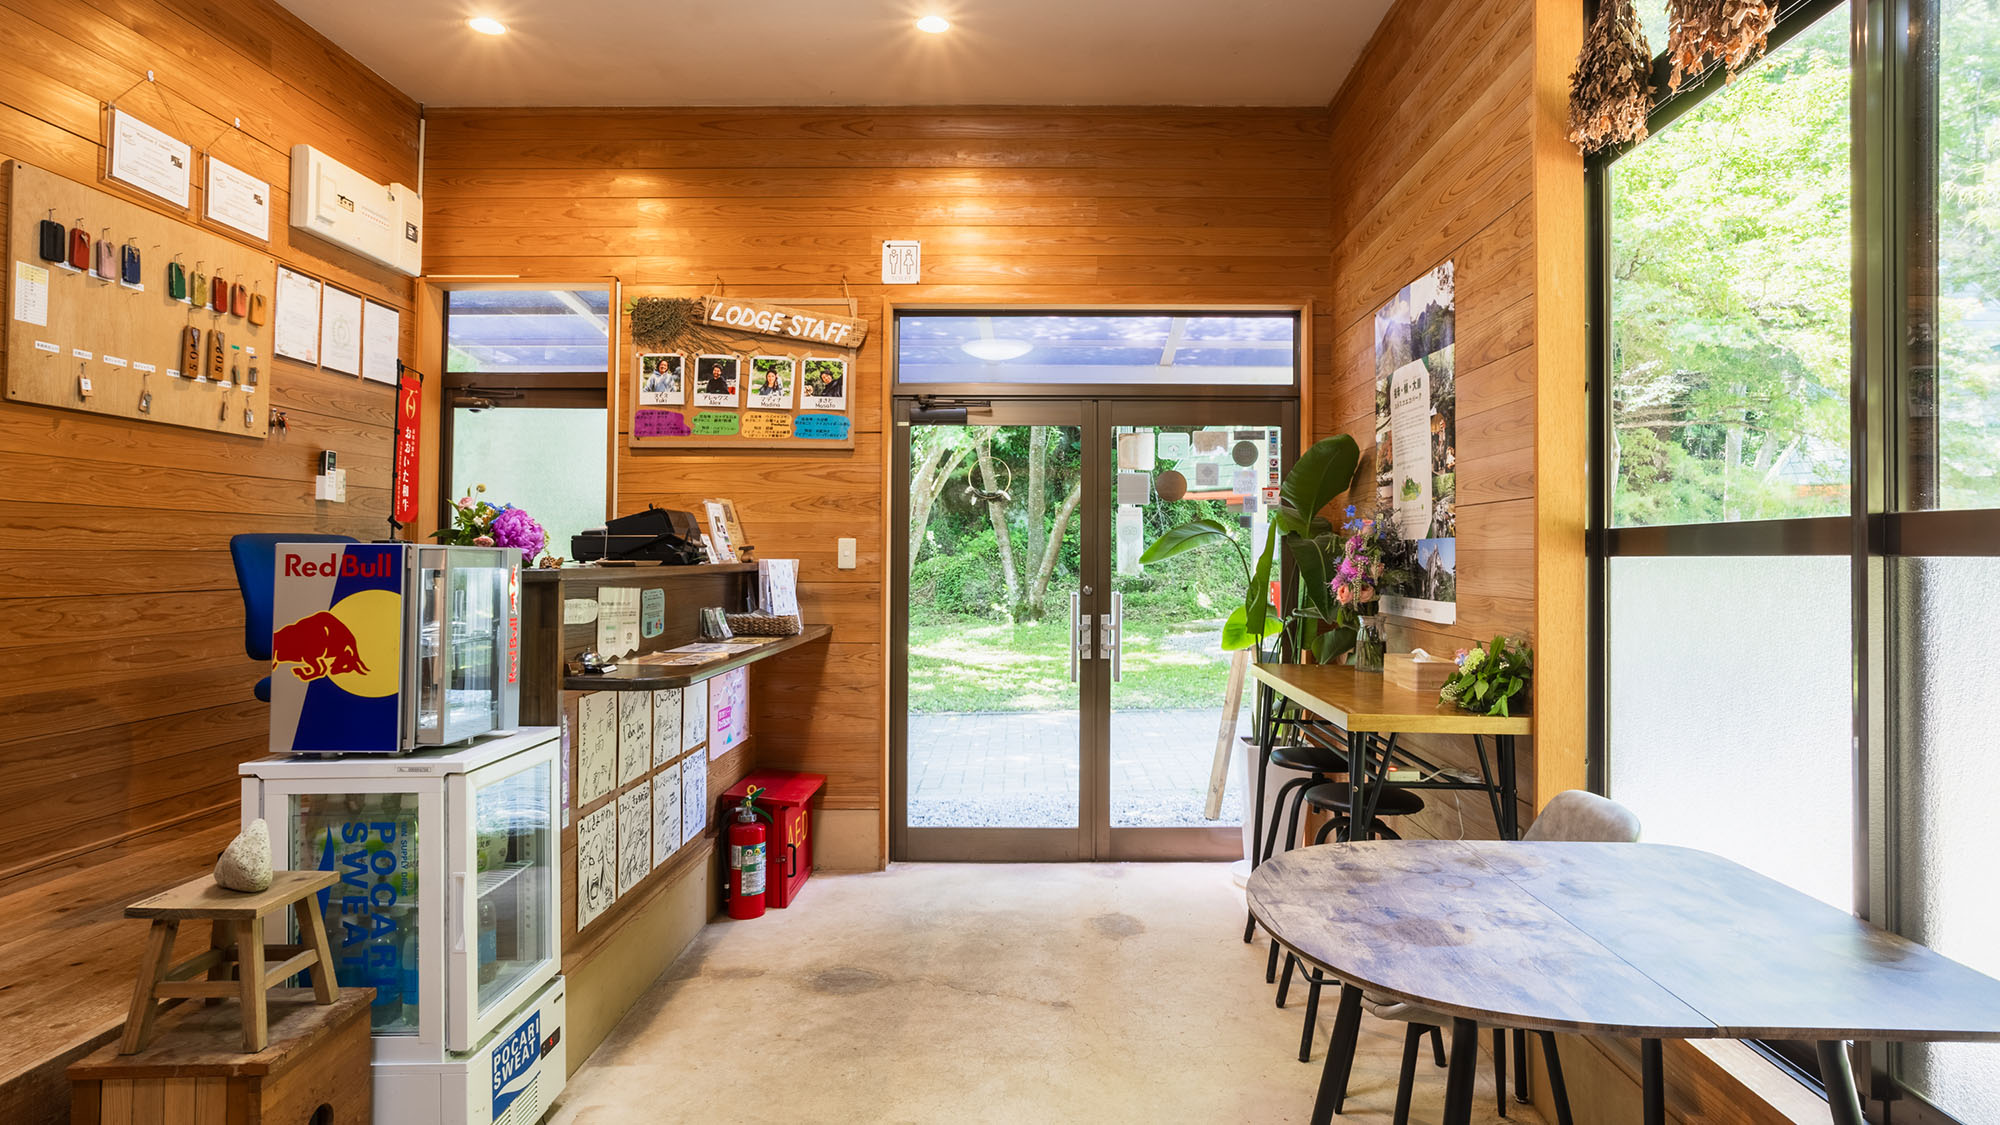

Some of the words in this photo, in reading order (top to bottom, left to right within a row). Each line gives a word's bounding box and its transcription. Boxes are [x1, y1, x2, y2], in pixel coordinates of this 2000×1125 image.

[710, 302, 786, 332] LODGE
[787, 315, 852, 344] STAFF
[284, 553, 337, 577] Red
[341, 553, 392, 577] Bull
[508, 616, 518, 650] Bull
[508, 651, 518, 683] Red
[788, 809, 809, 849] AED
[400, 840, 408, 870] SUPPLY
[341, 821, 369, 972] SWEAT
[369, 821, 398, 986] POCARI
[400, 871, 408, 897] DRINK
[493, 1017, 540, 1074] POCARI
[493, 1037, 536, 1091] SWEAT
